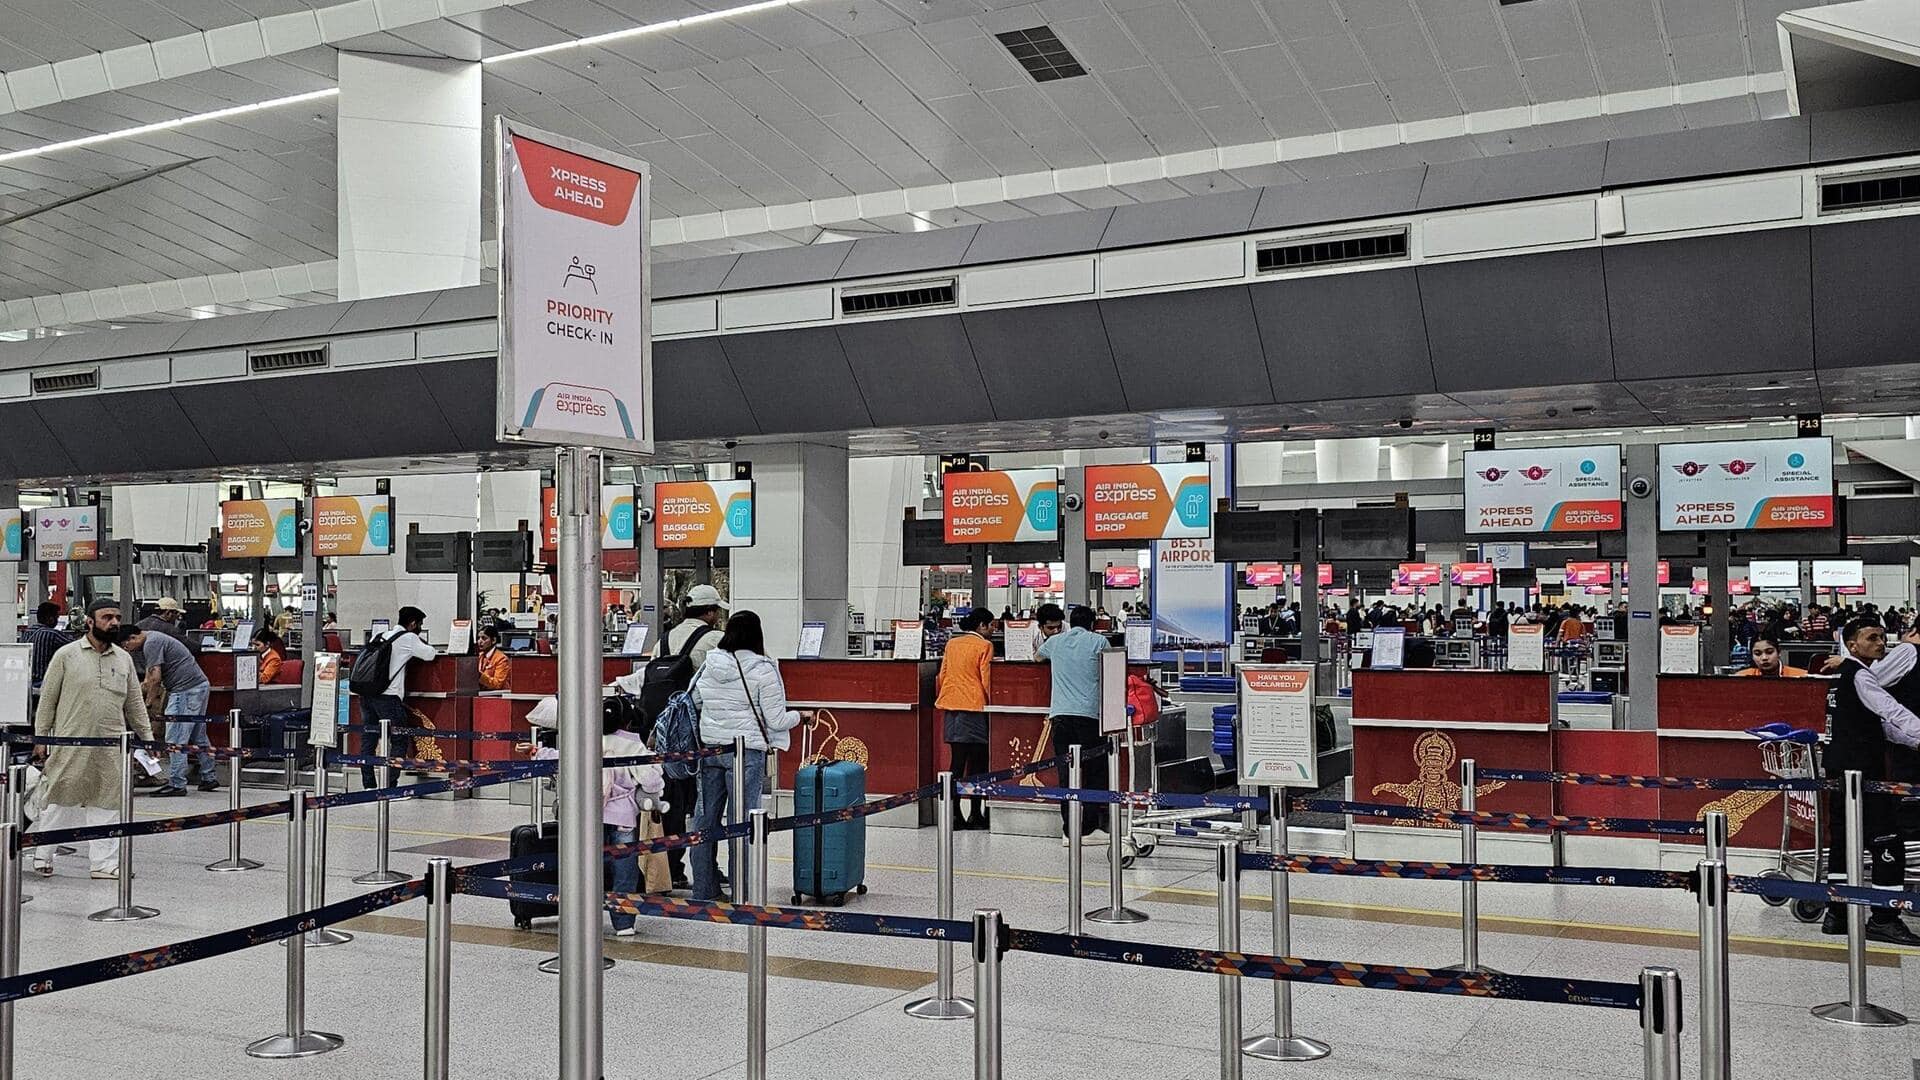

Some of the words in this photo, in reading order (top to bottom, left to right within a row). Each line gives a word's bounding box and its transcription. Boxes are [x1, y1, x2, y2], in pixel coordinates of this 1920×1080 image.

[551, 166, 607, 193] XPRESS
[554, 187, 604, 209] AHEAD
[547, 299, 613, 325] PRIORITY
[556, 392, 570, 400] AIR
[571, 393, 592, 403] INDIA
[556, 399, 606, 418] express
[1800, 419, 1819, 429] F13
[1475, 433, 1492, 442] F12
[1187, 447, 1201, 455] F11
[952, 457, 966, 465] F10
[1095, 482, 1111, 490] AIR
[1113, 482, 1138, 490] INDIA
[952, 494, 1009, 508] express
[1095, 488, 1157, 504] express
[663, 503, 711, 516] express
[1480, 506, 1533, 515] XPRESS
[1676, 502, 1735, 511] XPRESS
[318, 514, 357, 527] express
[1095, 511, 1149, 521] BAGGAGE
[1565, 514, 1614, 524] express
[1676, 514, 1735, 525] AHEAD
[1771, 510, 1825, 521] express
[227, 518, 265, 530] express
[953, 516, 1003, 526] BAGGAGE
[1480, 517, 1533, 527] AHEAD
[953, 527, 982, 536] DROP
[1095, 523, 1126, 532] DROP
[319, 533, 352, 541] BAGGAGE
[1171, 539, 1203, 548] BEST
[1160, 550, 1214, 562] AIRPOR
